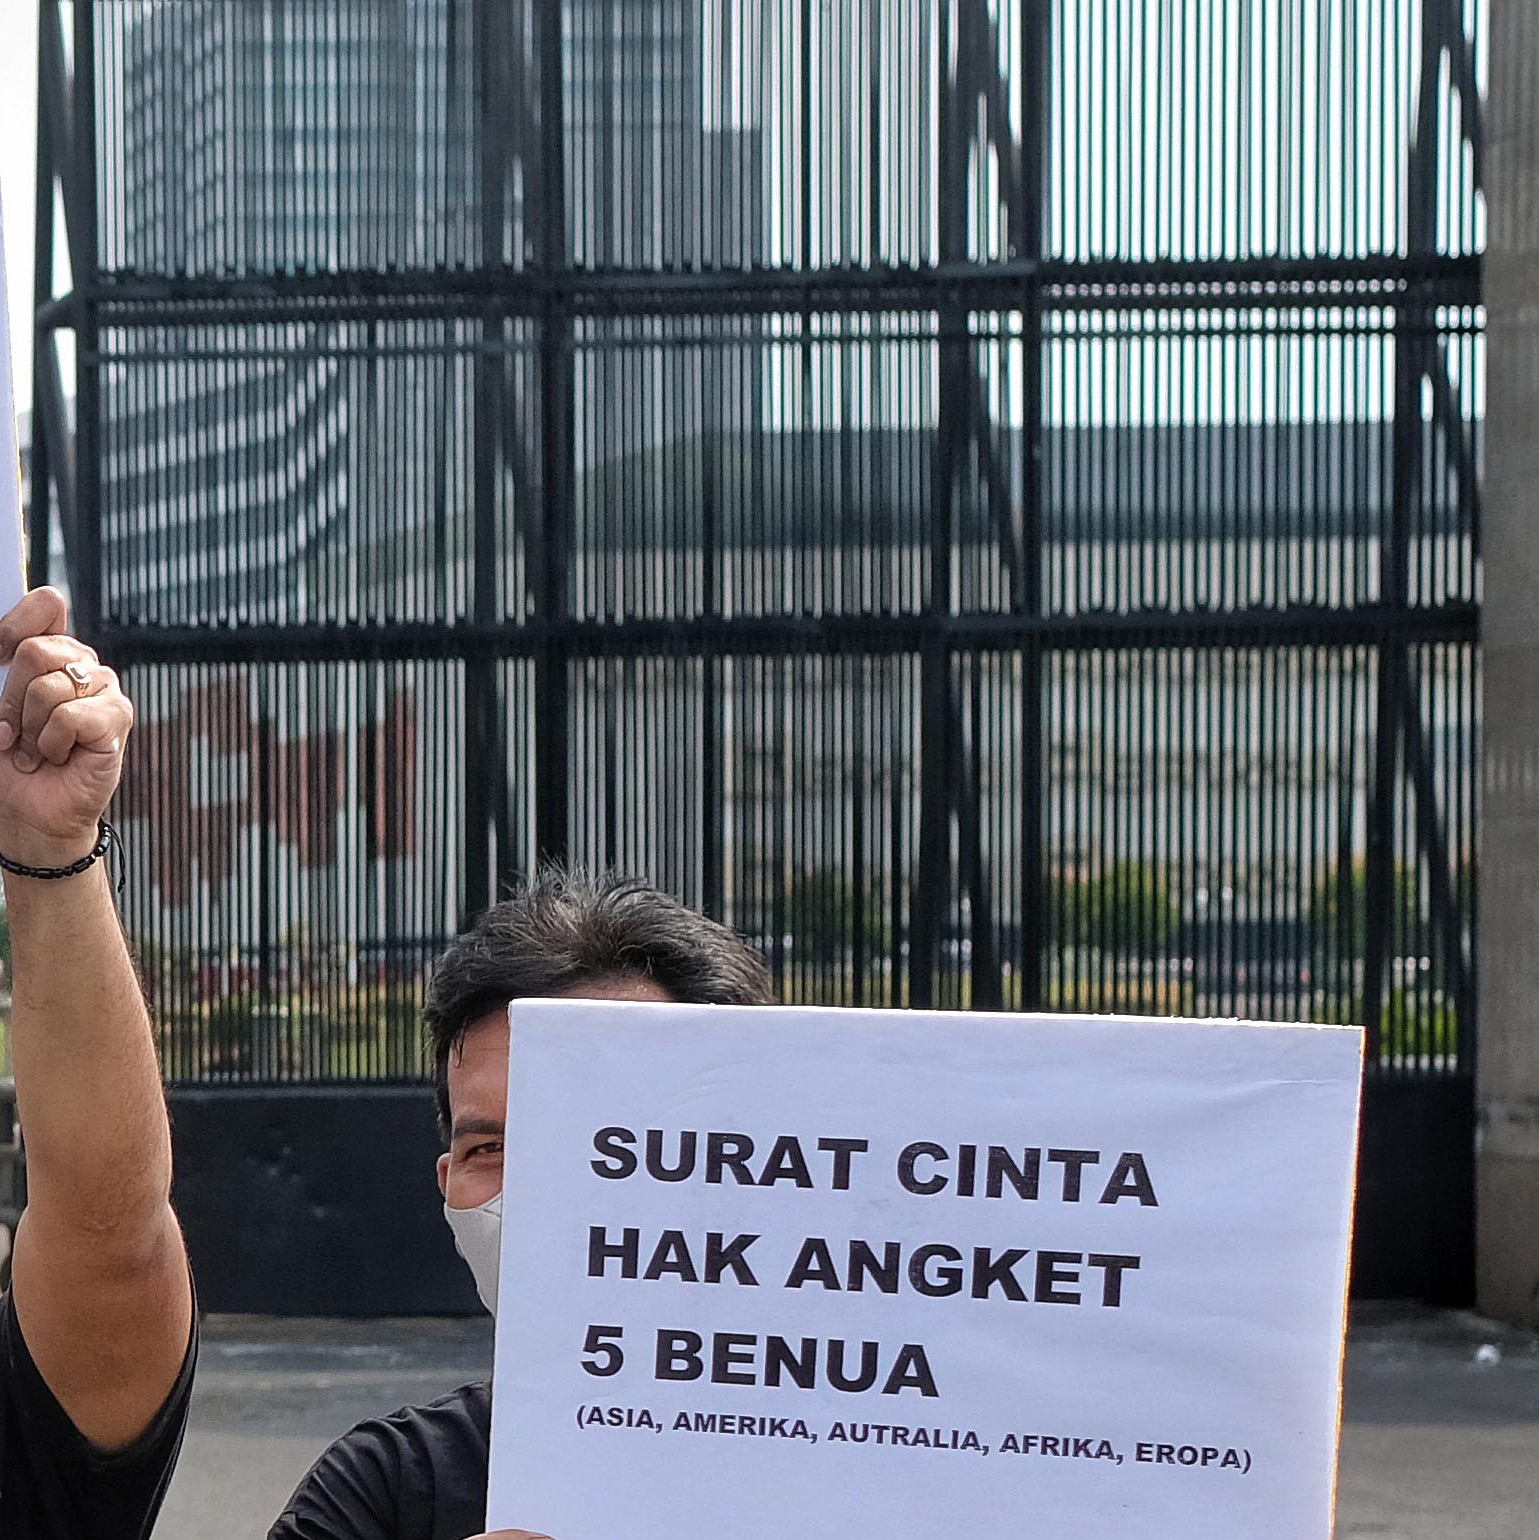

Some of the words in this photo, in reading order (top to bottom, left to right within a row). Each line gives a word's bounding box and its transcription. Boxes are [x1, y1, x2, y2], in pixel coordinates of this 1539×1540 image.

[590, 1127, 869, 1190] SURAT
[898, 1142, 1159, 1207] CINTA
[588, 1226, 761, 1286] HAK
[784, 1238, 1141, 1307] ANGKET
[581, 1325, 624, 1376] 5
[655, 1329, 939, 1397] BENUA
[577, 1405, 662, 1433] (ASIA,
[673, 1412, 817, 1444] AMERIKA,
[828, 1422, 989, 1456] AUTRALIA,
[999, 1434, 1123, 1465] AFRIKA,
[1136, 1443, 1251, 1474] EROPA)
